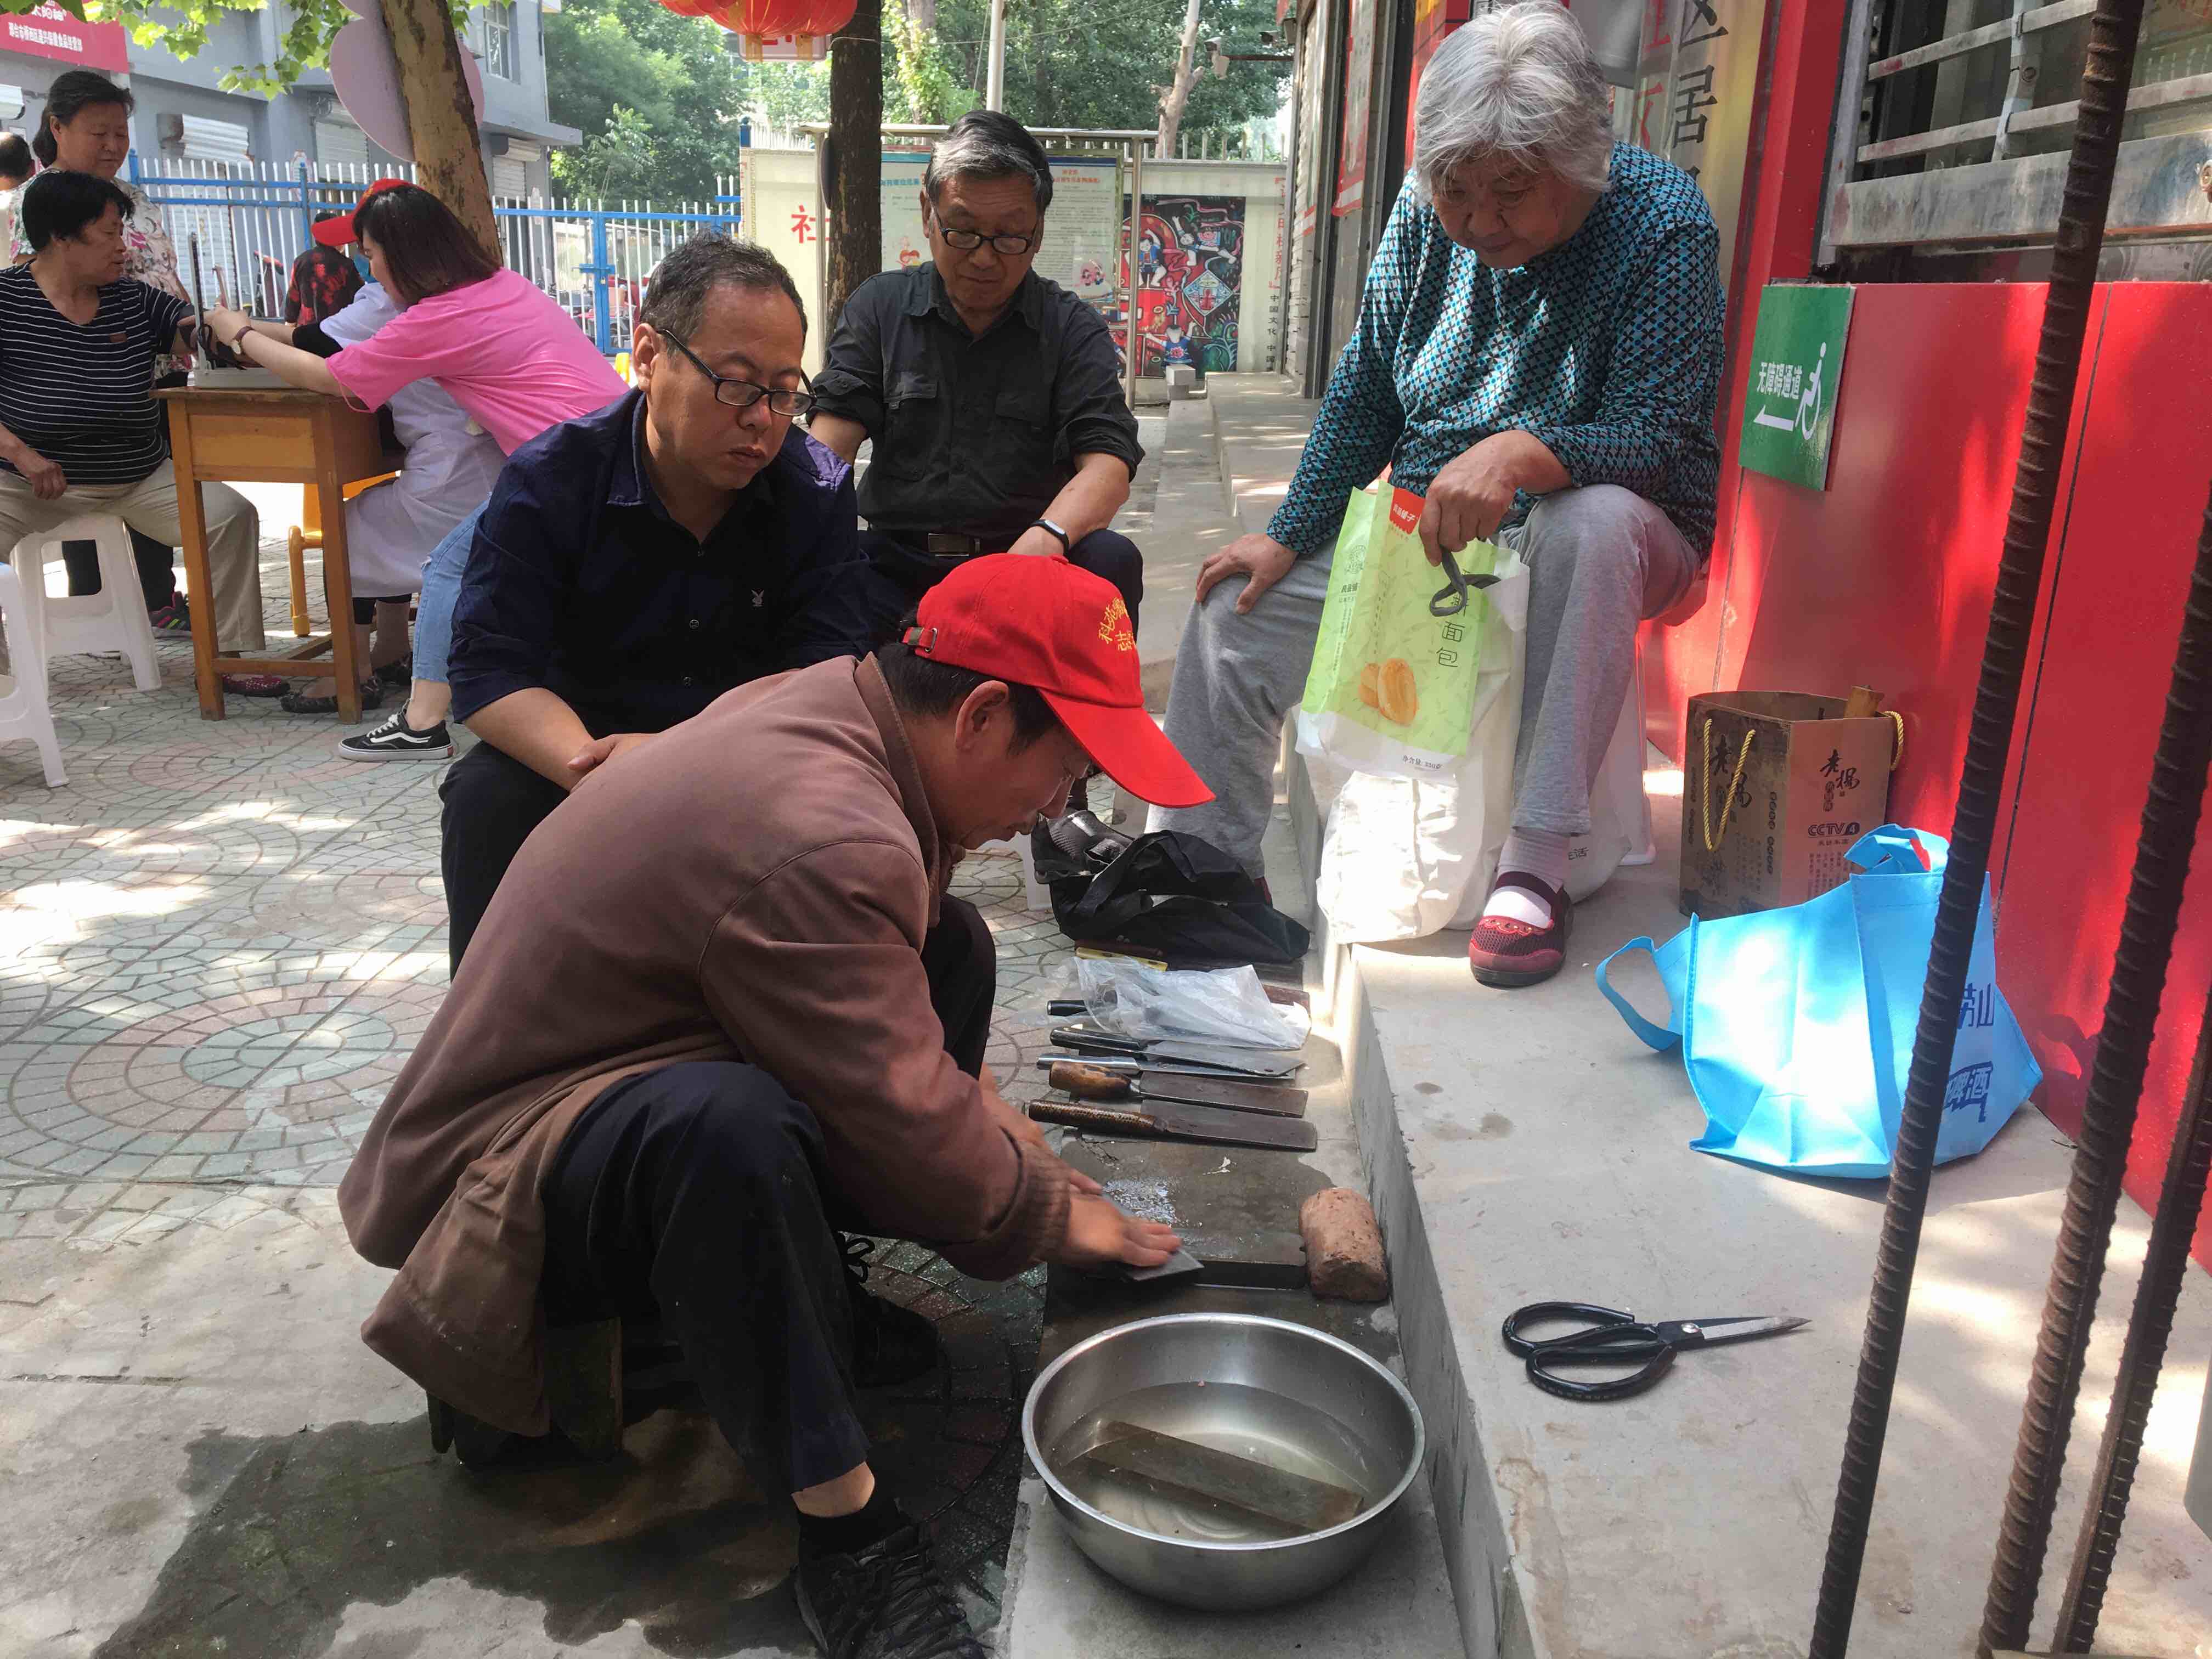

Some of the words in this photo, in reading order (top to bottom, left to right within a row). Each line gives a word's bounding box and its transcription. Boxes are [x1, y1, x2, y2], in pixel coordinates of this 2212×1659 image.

[1267, 294, 1279, 335] 中国文化
[1757, 362, 1803, 400] 无障碍通道
